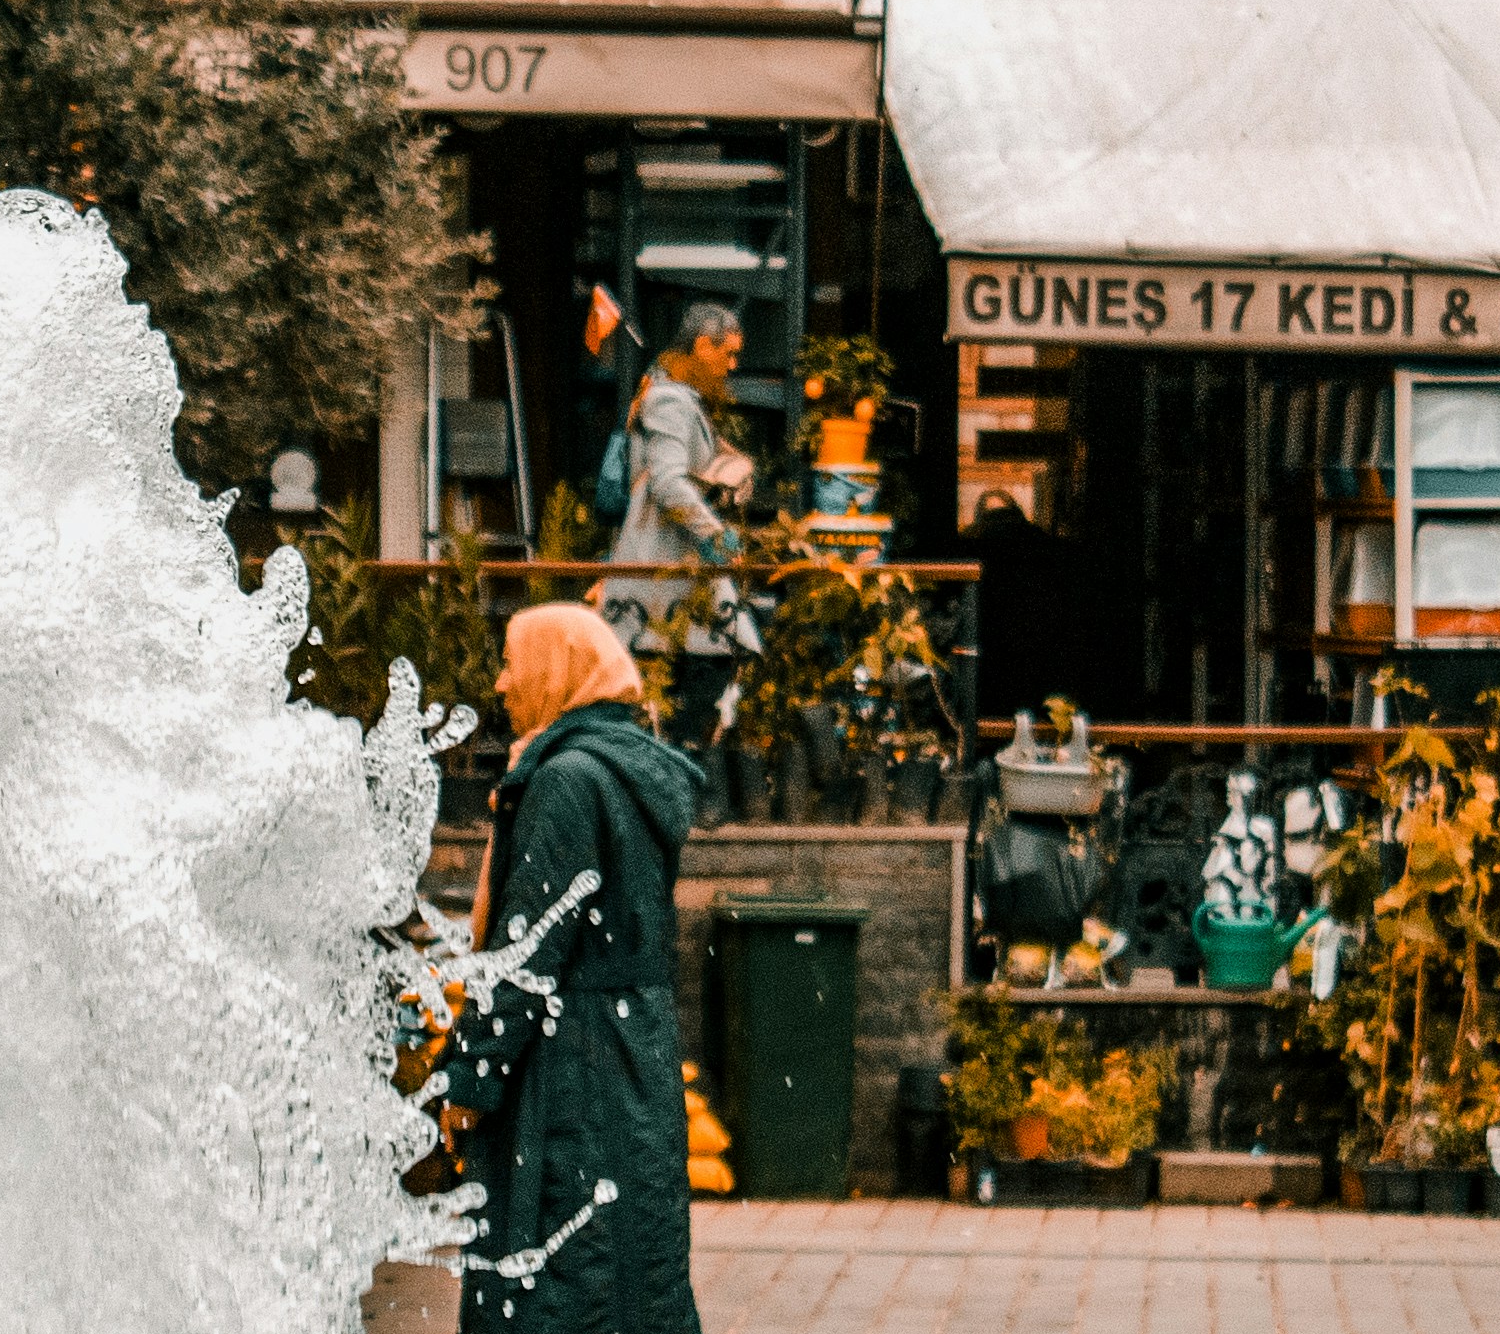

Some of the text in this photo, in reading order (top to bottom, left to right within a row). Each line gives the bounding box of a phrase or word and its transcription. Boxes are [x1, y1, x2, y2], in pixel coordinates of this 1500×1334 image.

[445, 42, 547, 93] 907
[962, 265, 1168, 335] GÜNEŞ
[1190, 280, 1256, 333] 17
[1276, 269, 1415, 339] KEDİ
[1439, 287, 1479, 339] &
